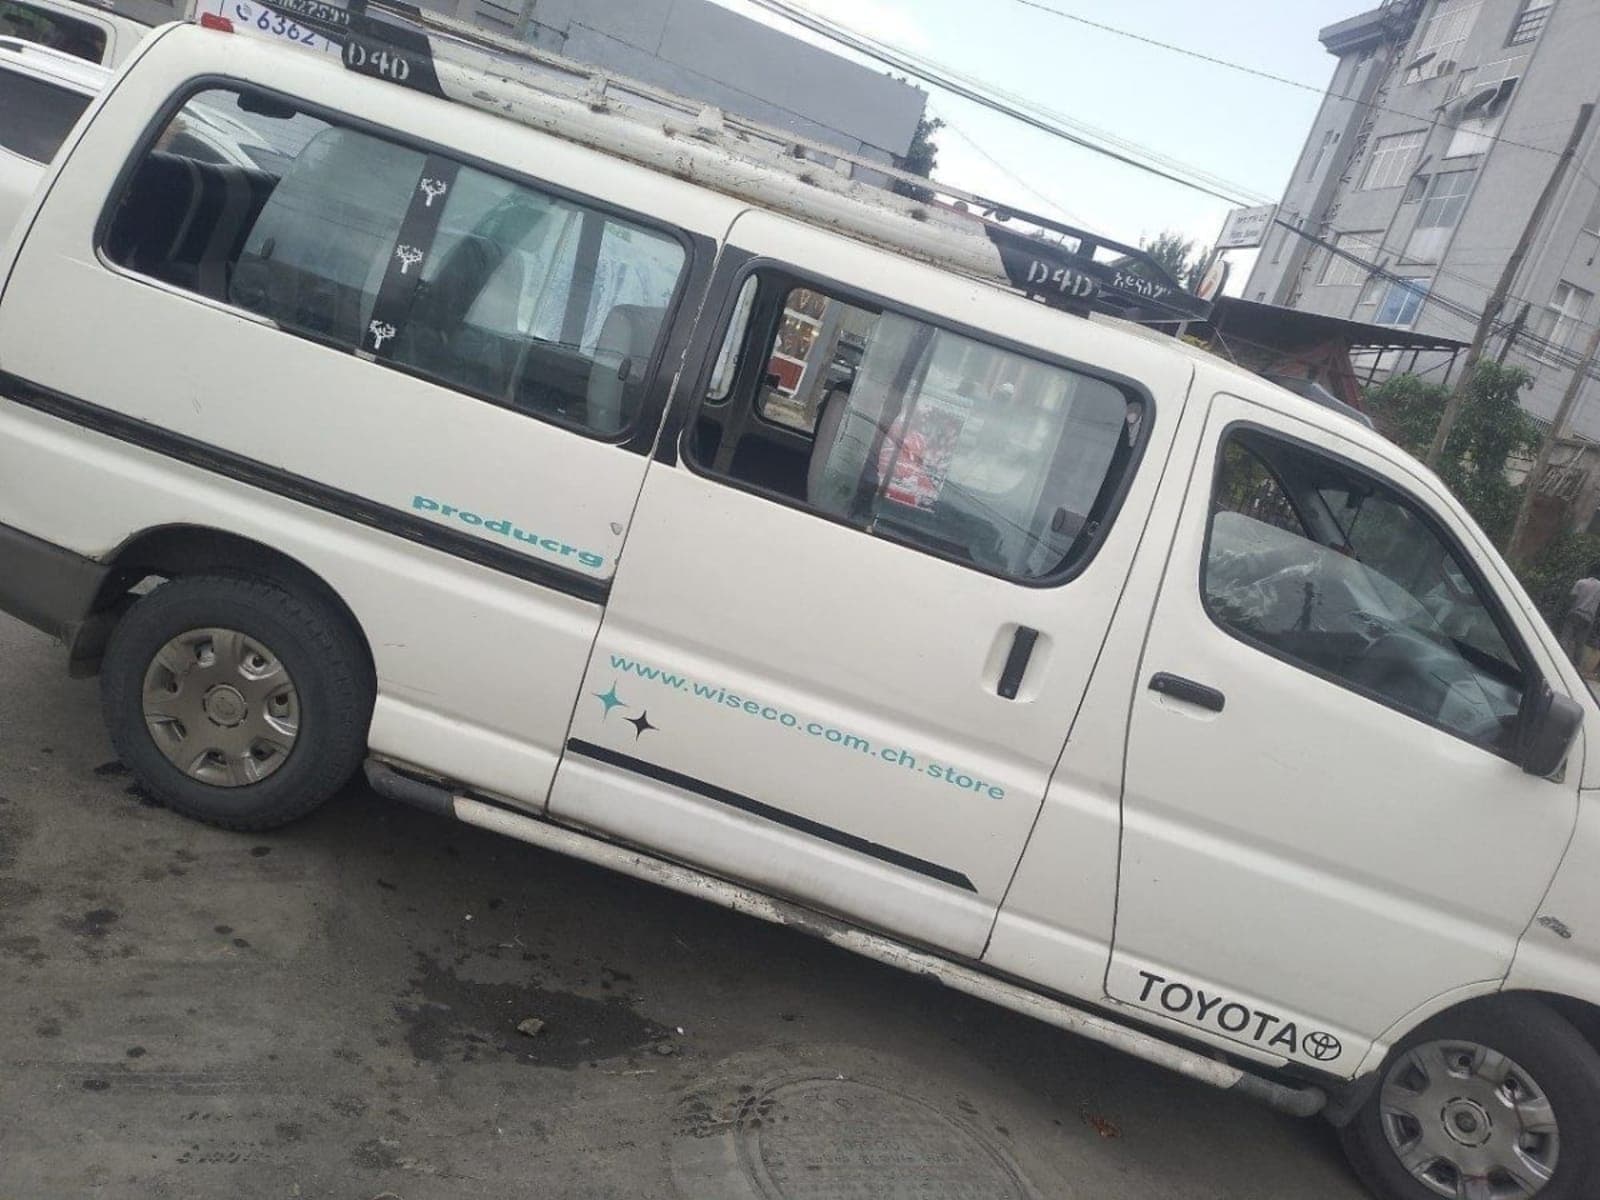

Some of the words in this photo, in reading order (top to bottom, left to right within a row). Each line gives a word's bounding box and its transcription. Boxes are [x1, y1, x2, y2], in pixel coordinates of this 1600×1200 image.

[1027, 260, 1093, 297] D4D
[412, 495, 604, 568] producrg
[610, 653, 1006, 801] www.wiseco.com.ch.store
[1139, 970, 1297, 1053] TOYOTA
